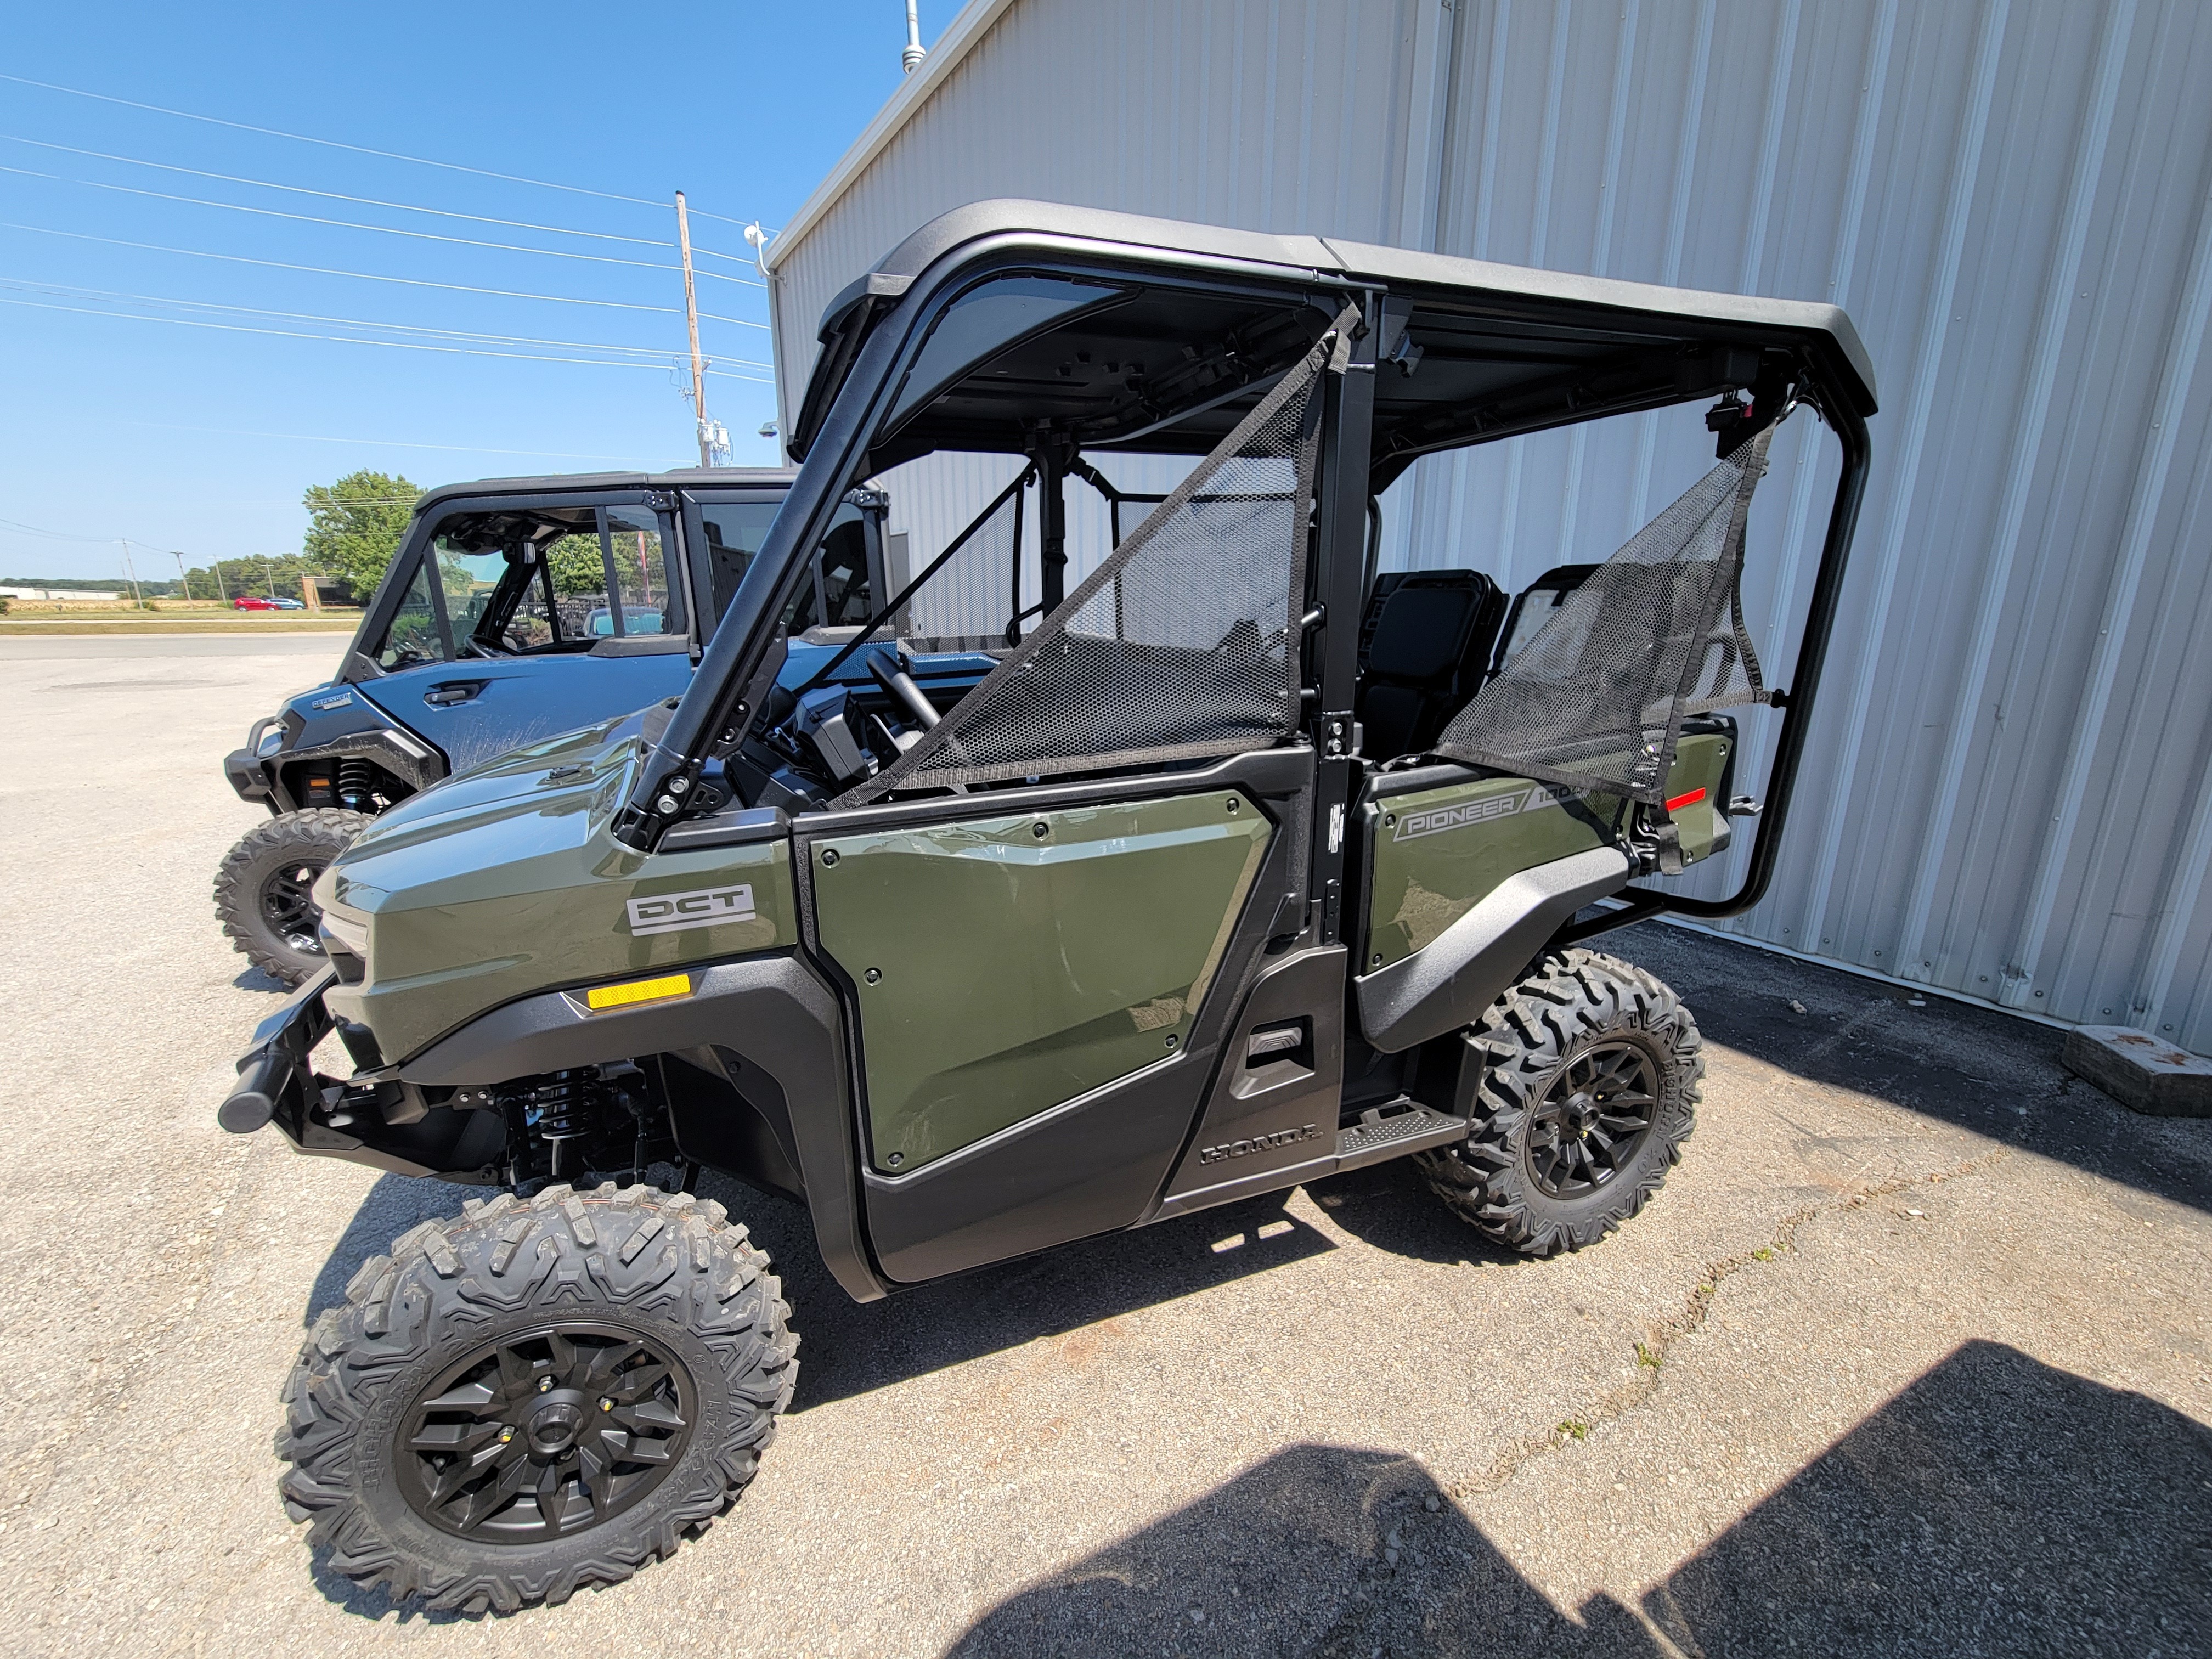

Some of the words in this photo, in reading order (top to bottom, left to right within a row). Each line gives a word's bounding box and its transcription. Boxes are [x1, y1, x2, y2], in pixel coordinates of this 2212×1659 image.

[1407, 797, 1515, 834] PIONEER
[637, 890, 744, 919] DCT
[1200, 1123, 1323, 1165] HONDA
